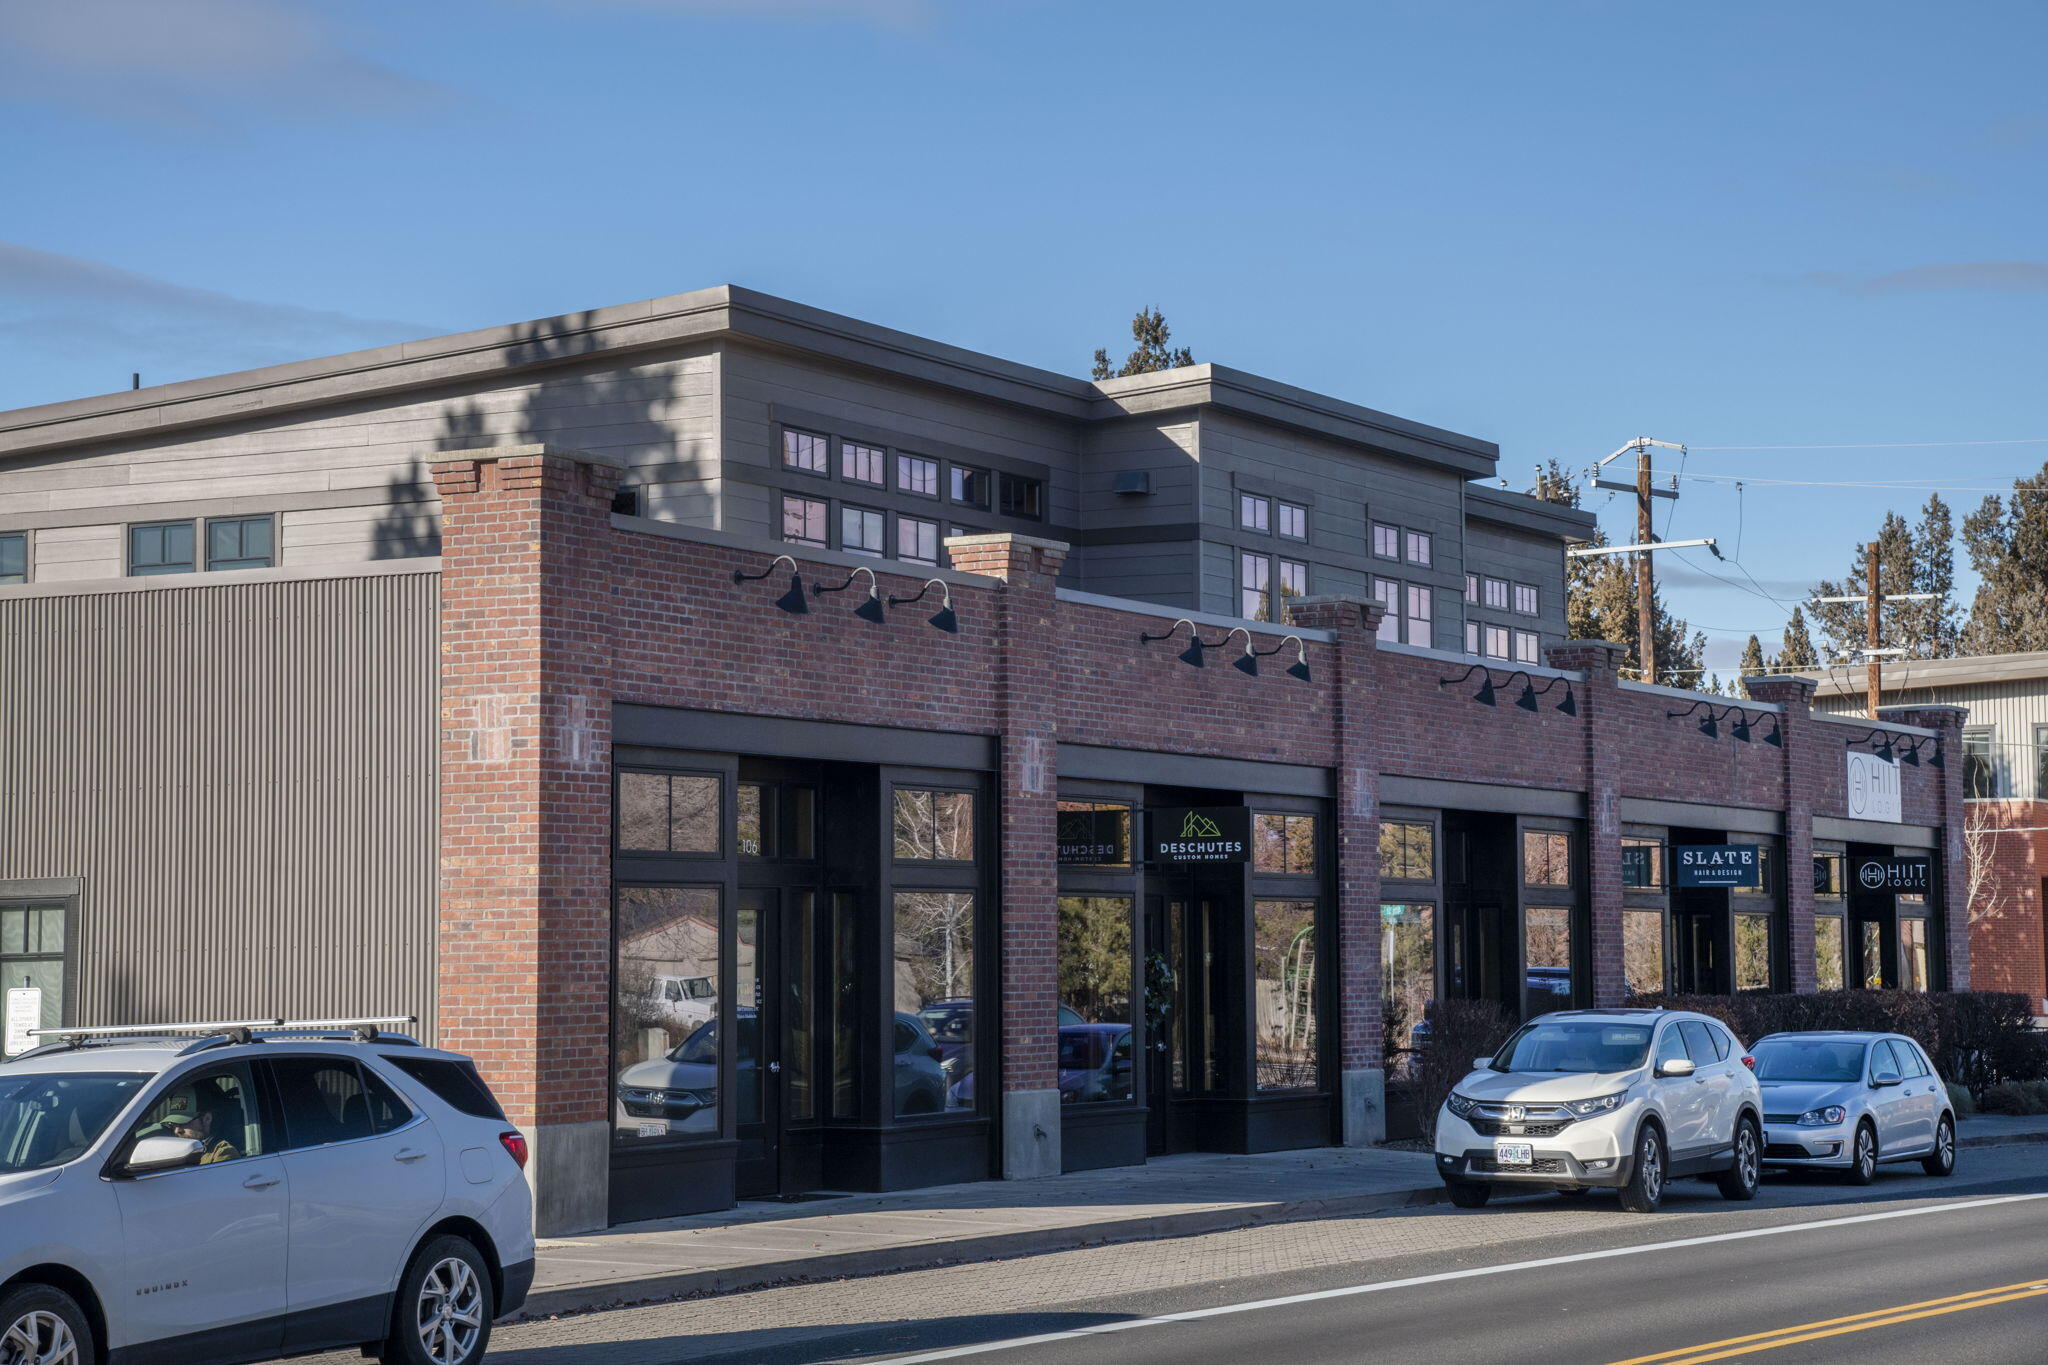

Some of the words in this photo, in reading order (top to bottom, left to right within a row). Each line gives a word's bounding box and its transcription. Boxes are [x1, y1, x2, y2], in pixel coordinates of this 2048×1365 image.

[743, 839, 758, 853] 106
[1160, 842, 1242, 853] DESCHUTES
[1683, 851, 1752, 865] SLATE
[1887, 864, 1927, 878] HIIT
[1887, 879, 1926, 887] LOGIC
